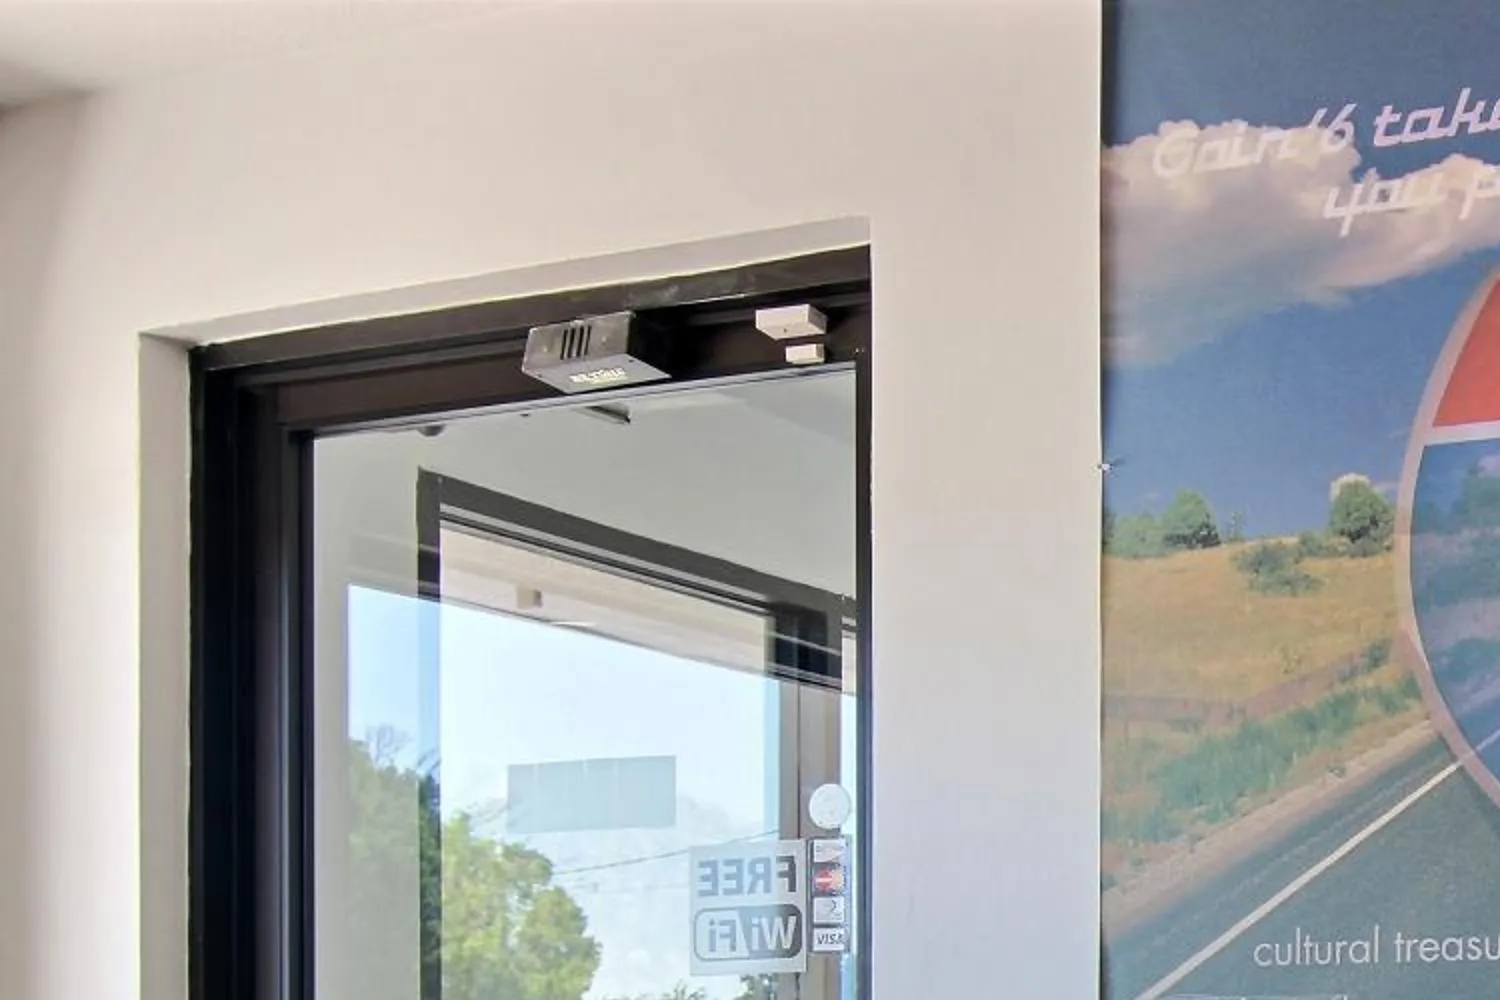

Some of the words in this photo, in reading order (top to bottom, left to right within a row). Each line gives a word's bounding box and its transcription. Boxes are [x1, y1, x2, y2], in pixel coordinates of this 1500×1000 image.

[1324, 169, 1446, 237] you
[817, 933, 844, 945] VISA
[1253, 926, 1380, 967] cultural
